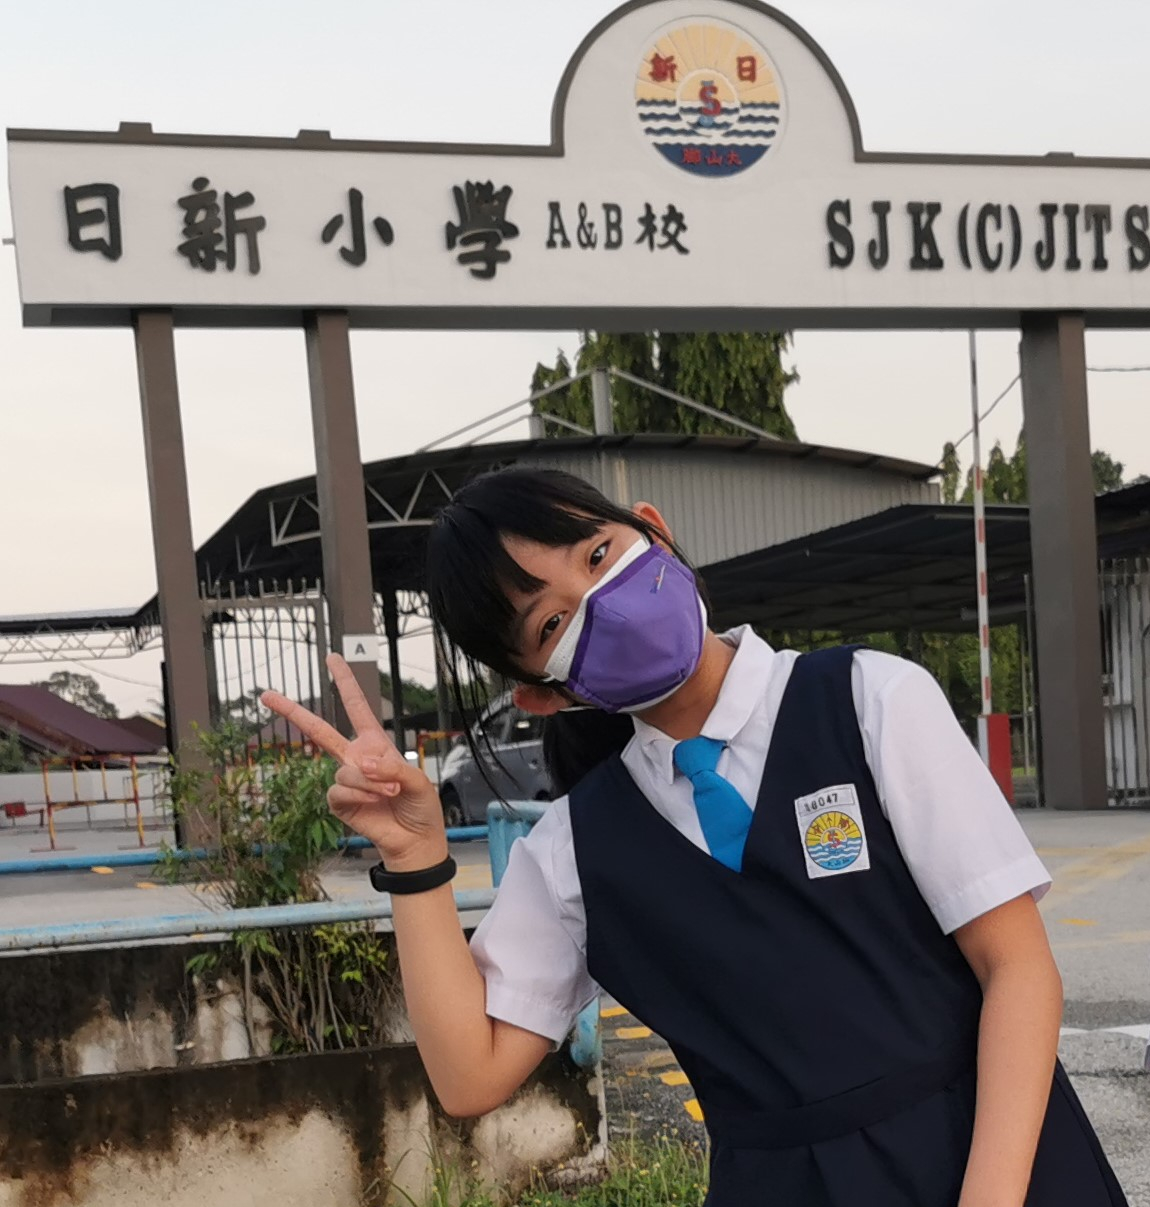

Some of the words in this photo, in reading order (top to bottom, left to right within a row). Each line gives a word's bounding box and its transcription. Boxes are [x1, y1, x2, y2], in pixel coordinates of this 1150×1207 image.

[699, 85, 721, 116] S
[62, 176, 519, 281] 日新小學
[1034, 203, 1111, 272] JIT
[355, 643, 366, 655] A
